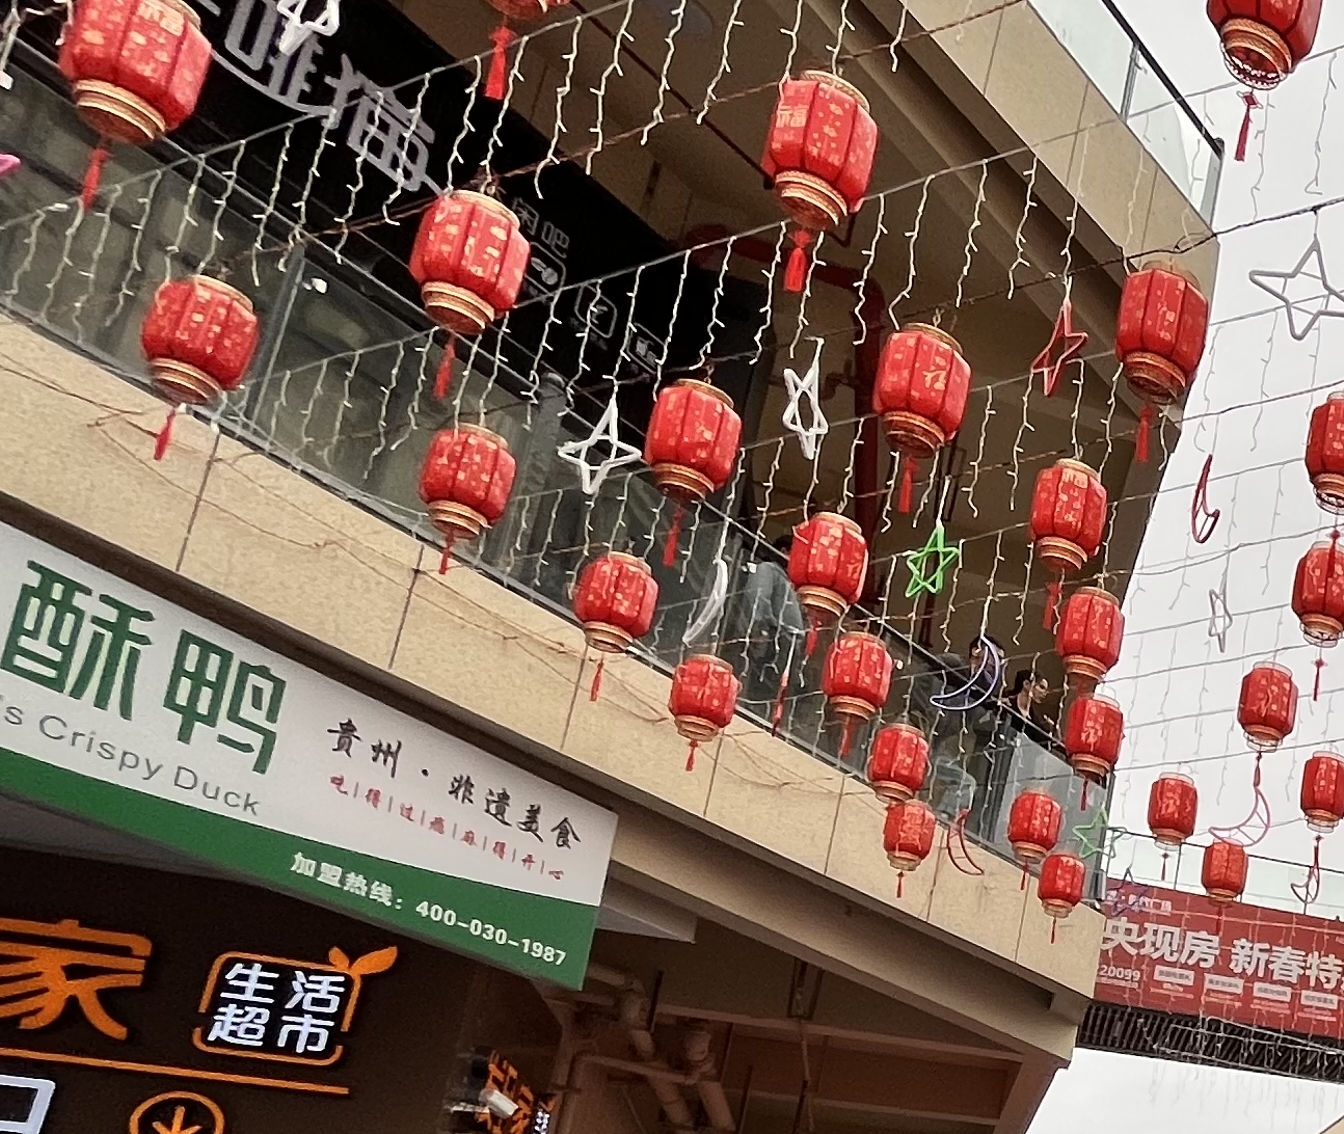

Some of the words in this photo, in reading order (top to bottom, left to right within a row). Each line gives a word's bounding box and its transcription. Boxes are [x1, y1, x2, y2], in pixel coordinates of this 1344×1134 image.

[0, 560, 287, 775] 酥鸭
[38, 715, 163, 781] Crispy
[173, 766, 261, 816] Duck
[416, 900, 567, 966] 400-030-1987
[1101, 916, 1220, 969] 央现房
[223, 962, 347, 1014] 生活
[207, 1003, 336, 1054] 超市
